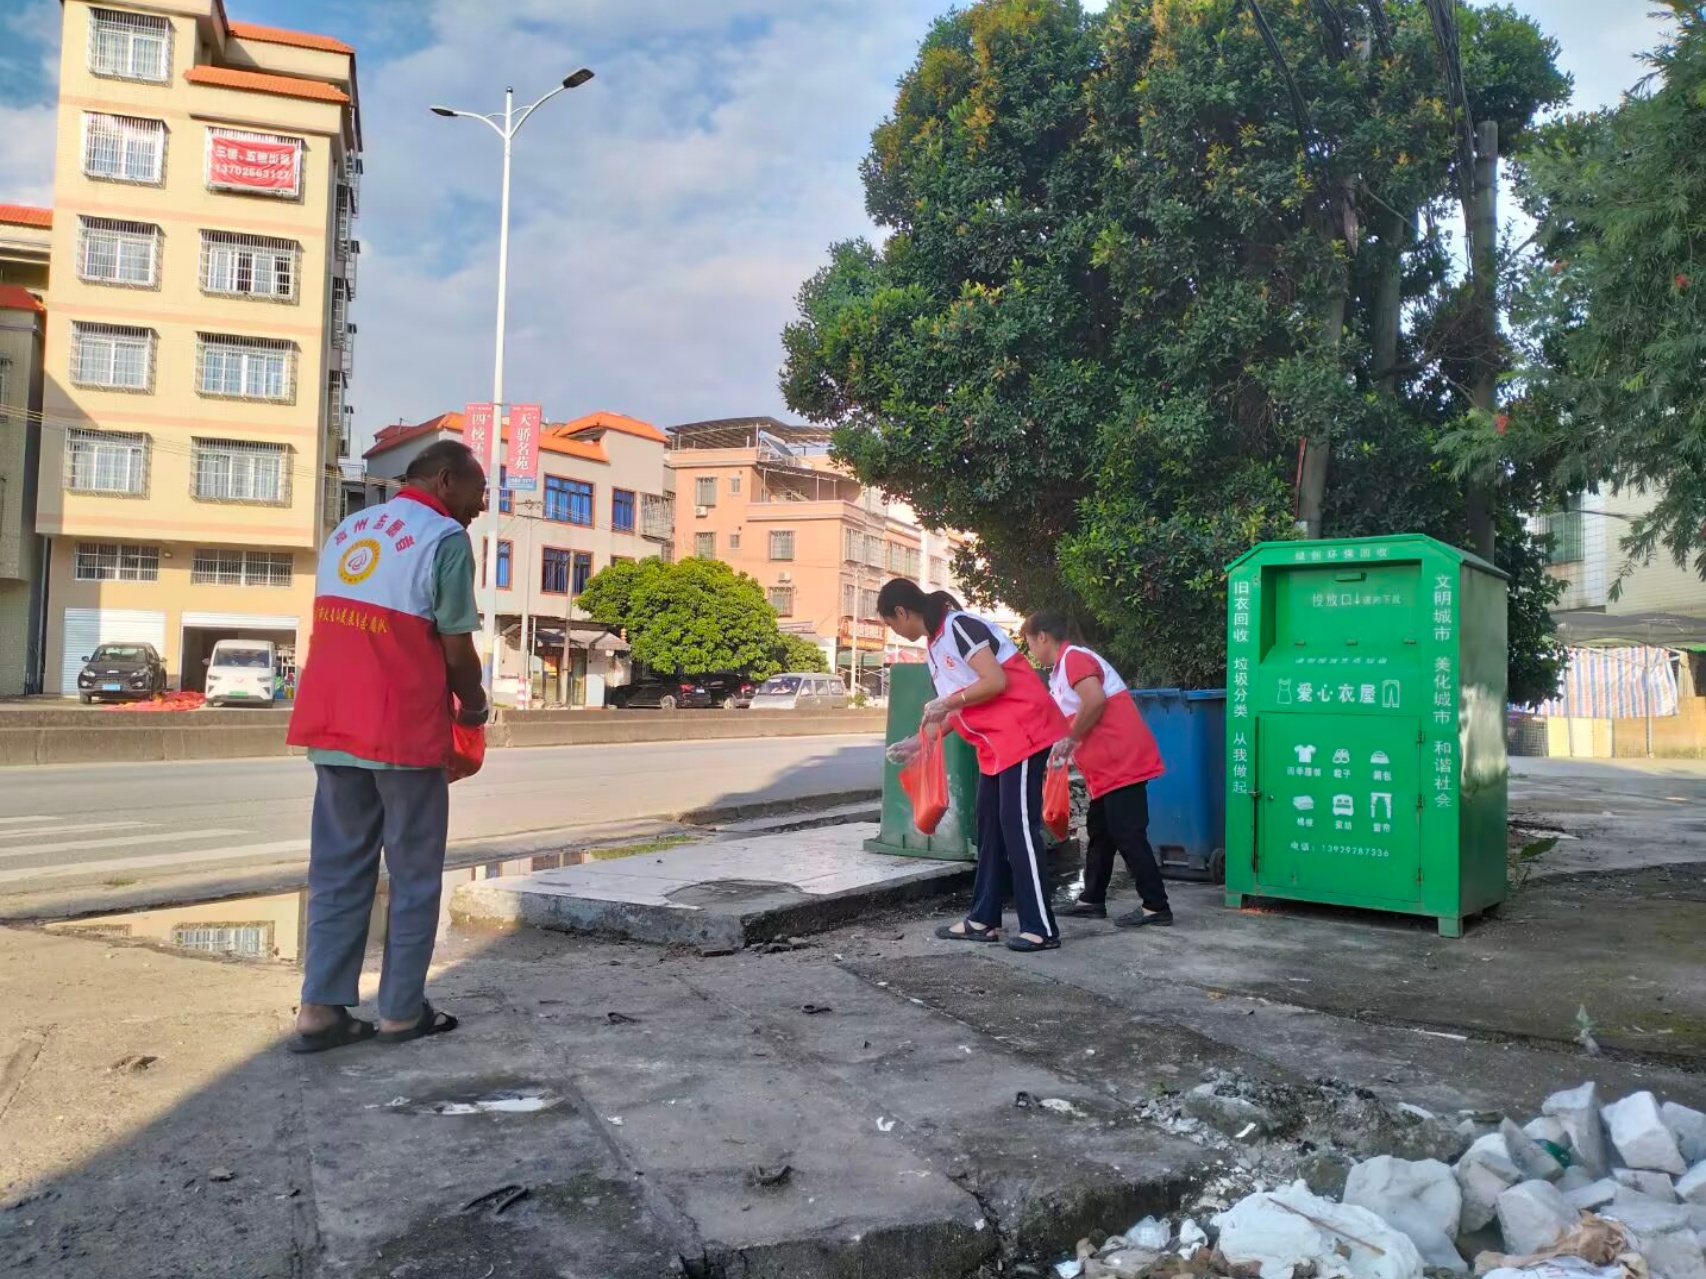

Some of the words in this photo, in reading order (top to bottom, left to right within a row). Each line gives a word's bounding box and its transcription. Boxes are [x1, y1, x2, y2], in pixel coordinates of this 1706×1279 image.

[1233, 581, 1249, 643] 旧衣回收
[1434, 574, 1451, 641] 文明城市
[1233, 657, 1249, 718] 垃圾分类
[1297, 682, 1377, 704] 爱心衣屋
[1434, 657, 1451, 723] 美化城市
[1233, 732, 1248, 794] 从我做起
[1434, 741, 1451, 807] 和谐社会
